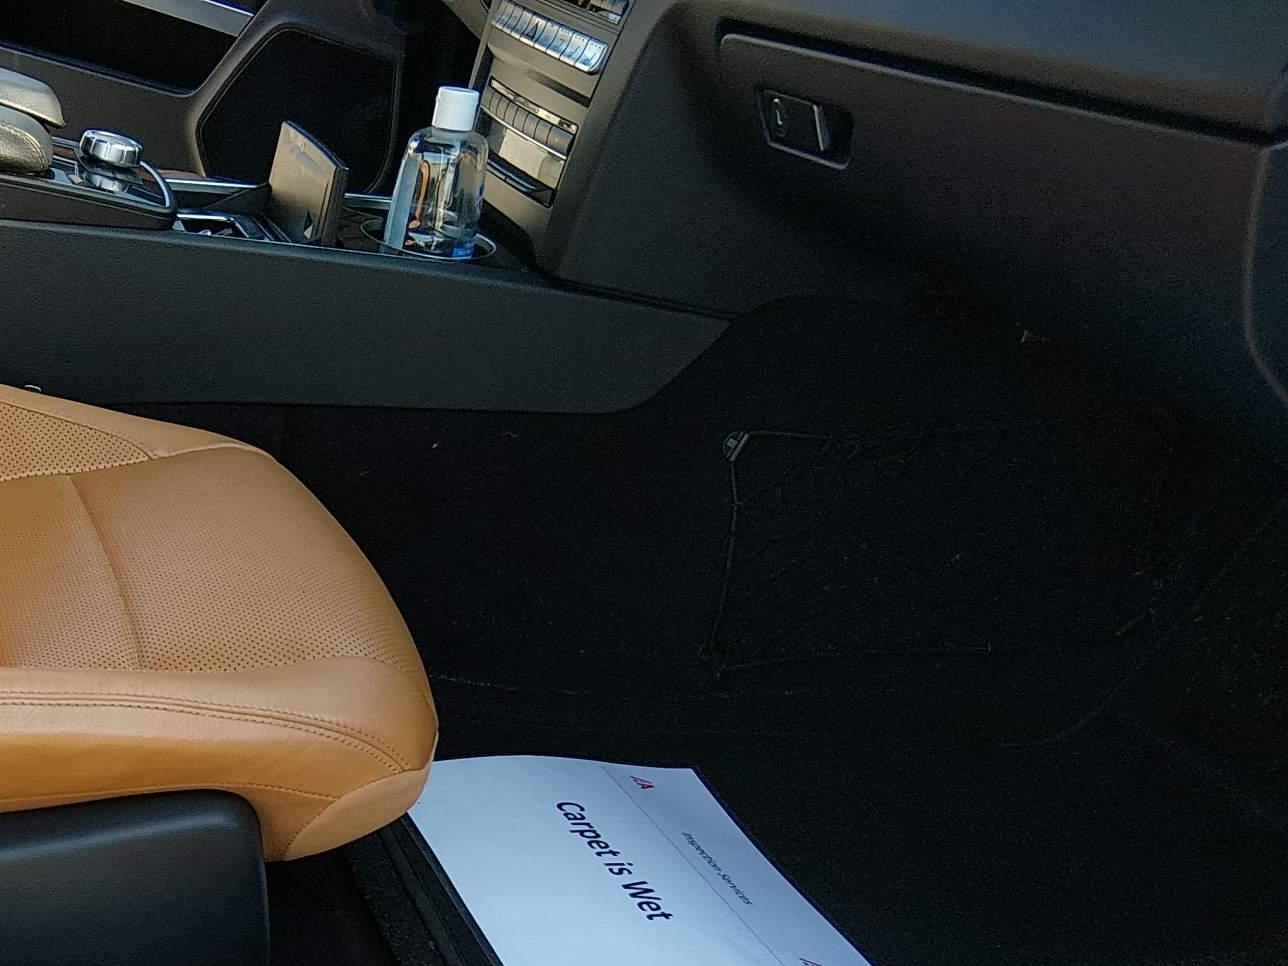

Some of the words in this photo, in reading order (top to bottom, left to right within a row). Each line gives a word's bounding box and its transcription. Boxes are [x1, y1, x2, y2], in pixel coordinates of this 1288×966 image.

[556, 801, 621, 857] Carpet
[603, 862, 634, 876] is
[621, 880, 674, 921] Wet
[680, 831, 723, 877] Inspection
[721, 873, 753, 905] Services
